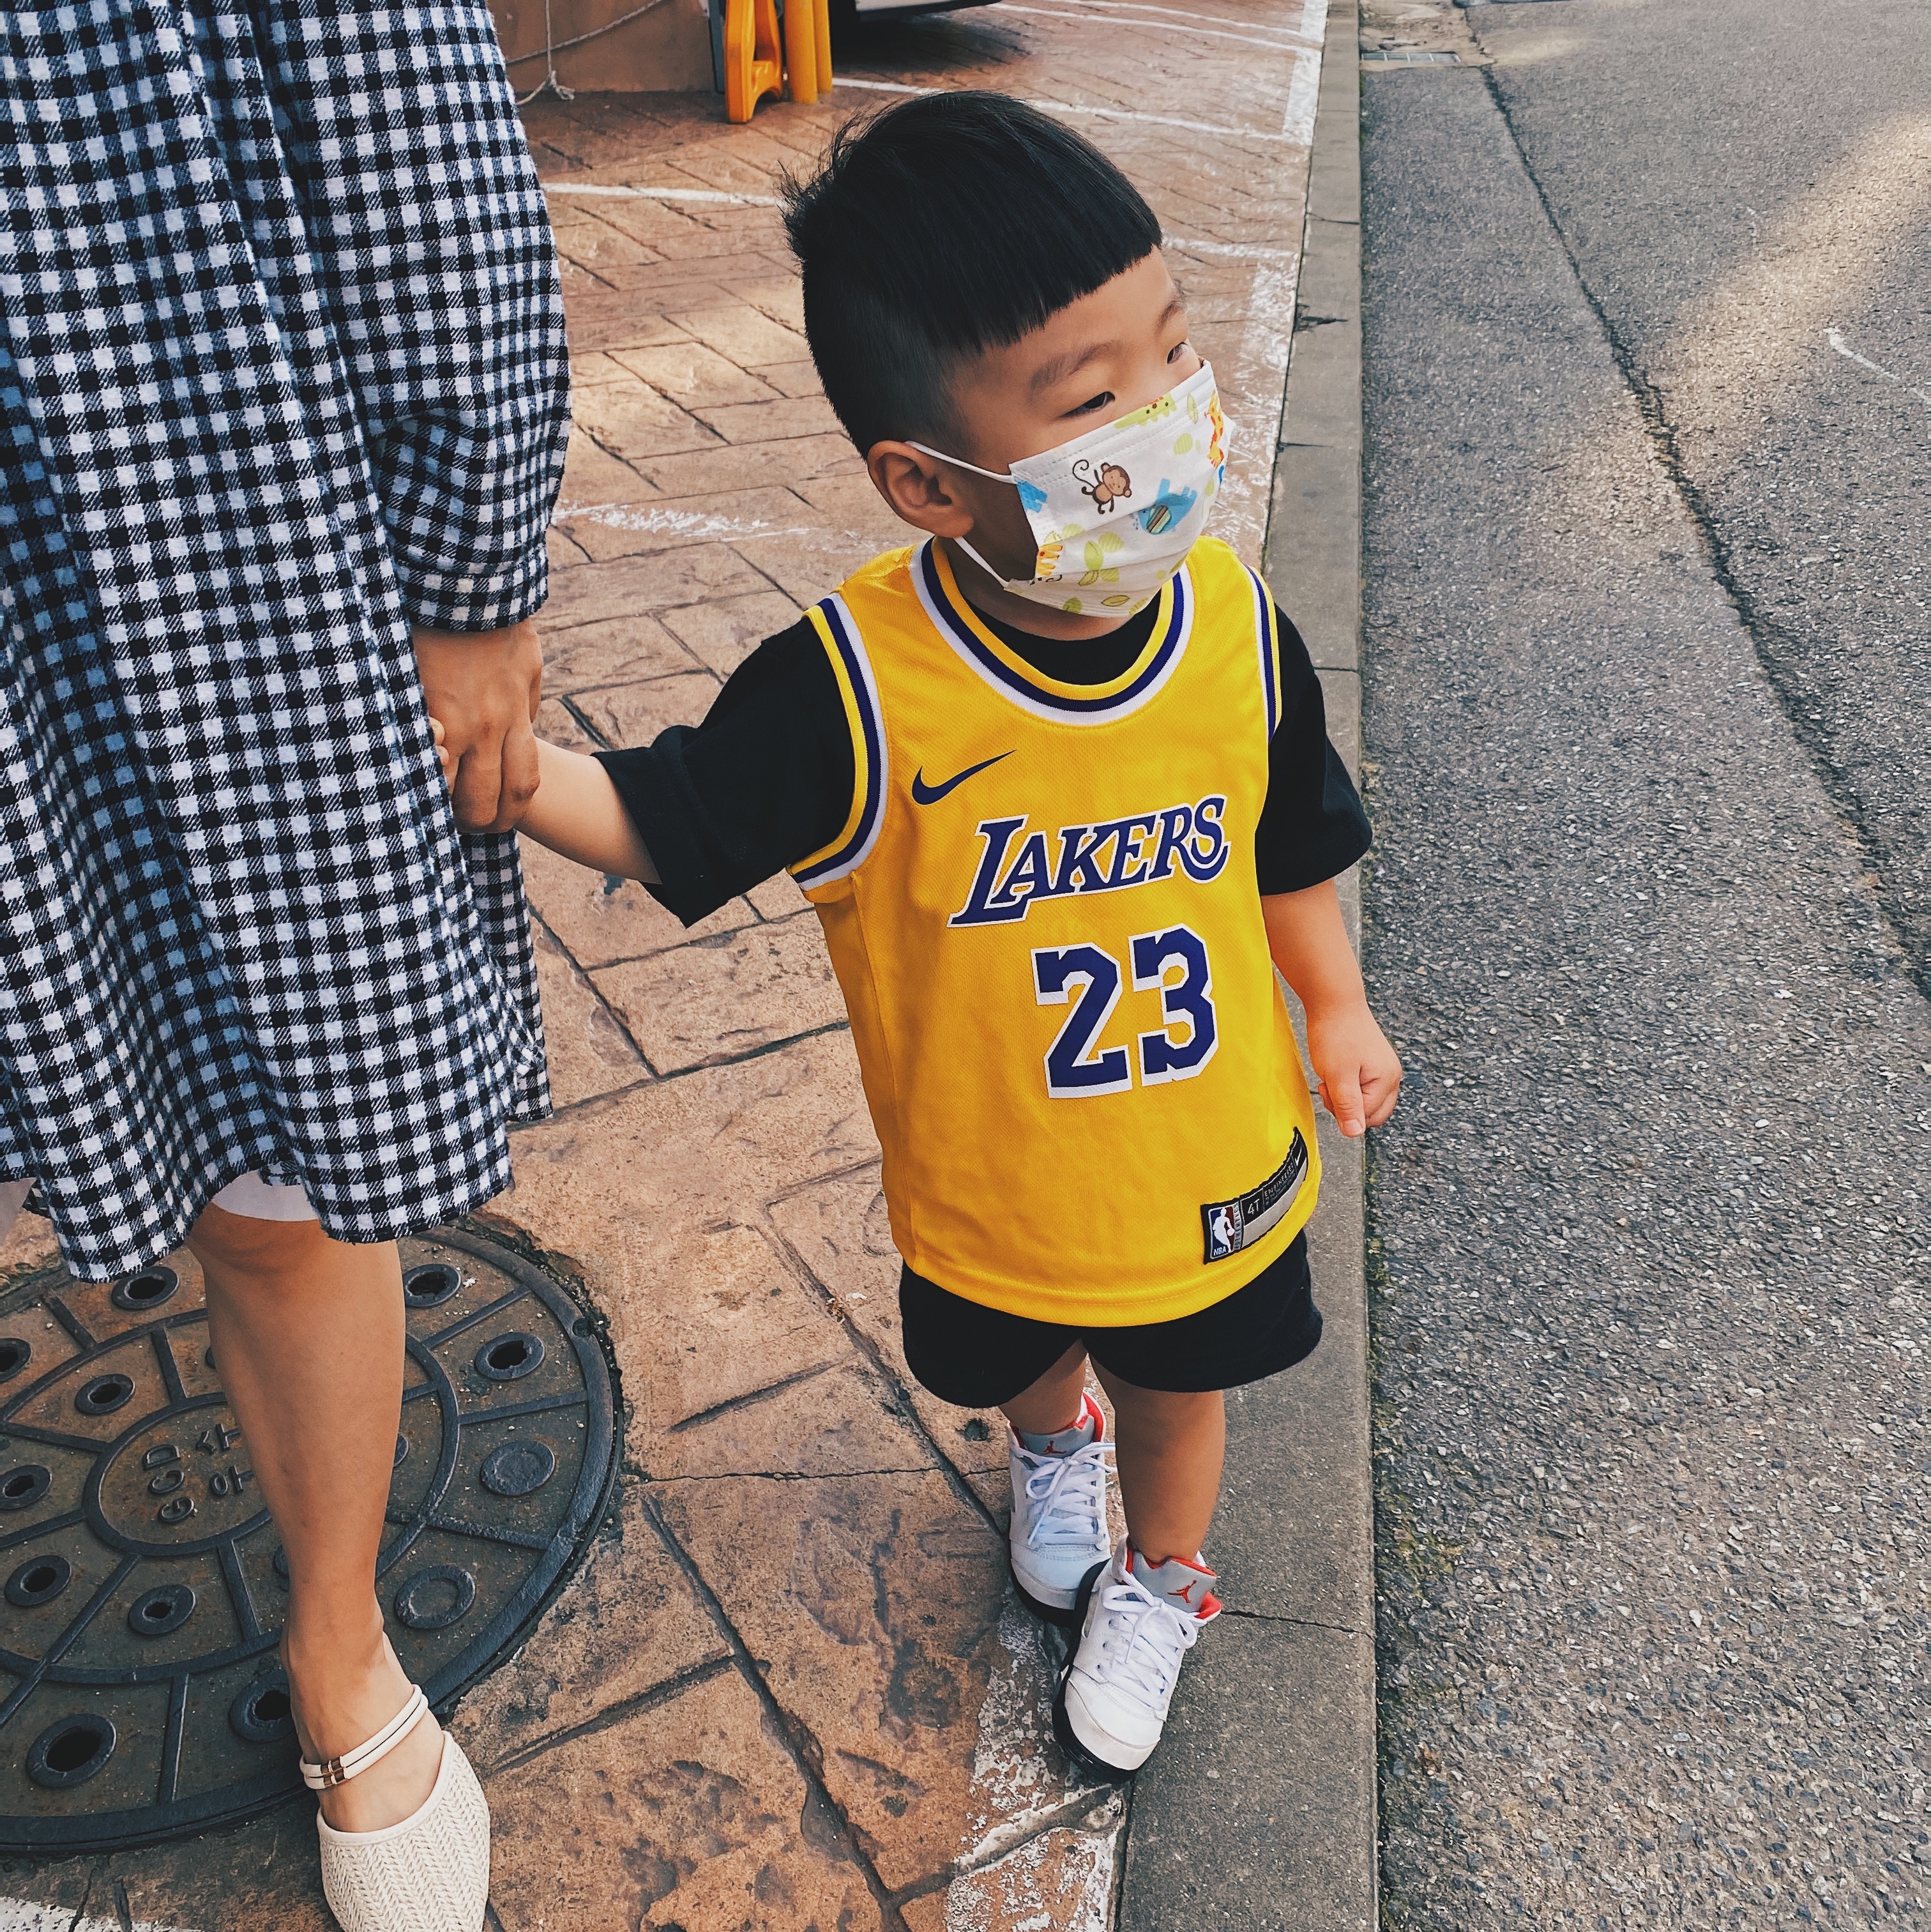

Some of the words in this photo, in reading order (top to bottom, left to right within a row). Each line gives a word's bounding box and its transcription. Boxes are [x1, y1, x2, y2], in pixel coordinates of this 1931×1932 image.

[947, 794, 1231, 927] LAKERS
[1031, 923, 1218, 1099] 23
[1248, 1199, 1259, 1215] 4T
[1214, 1246, 1227, 1256] NBA
[142, 1444, 194, 1523] GCD
